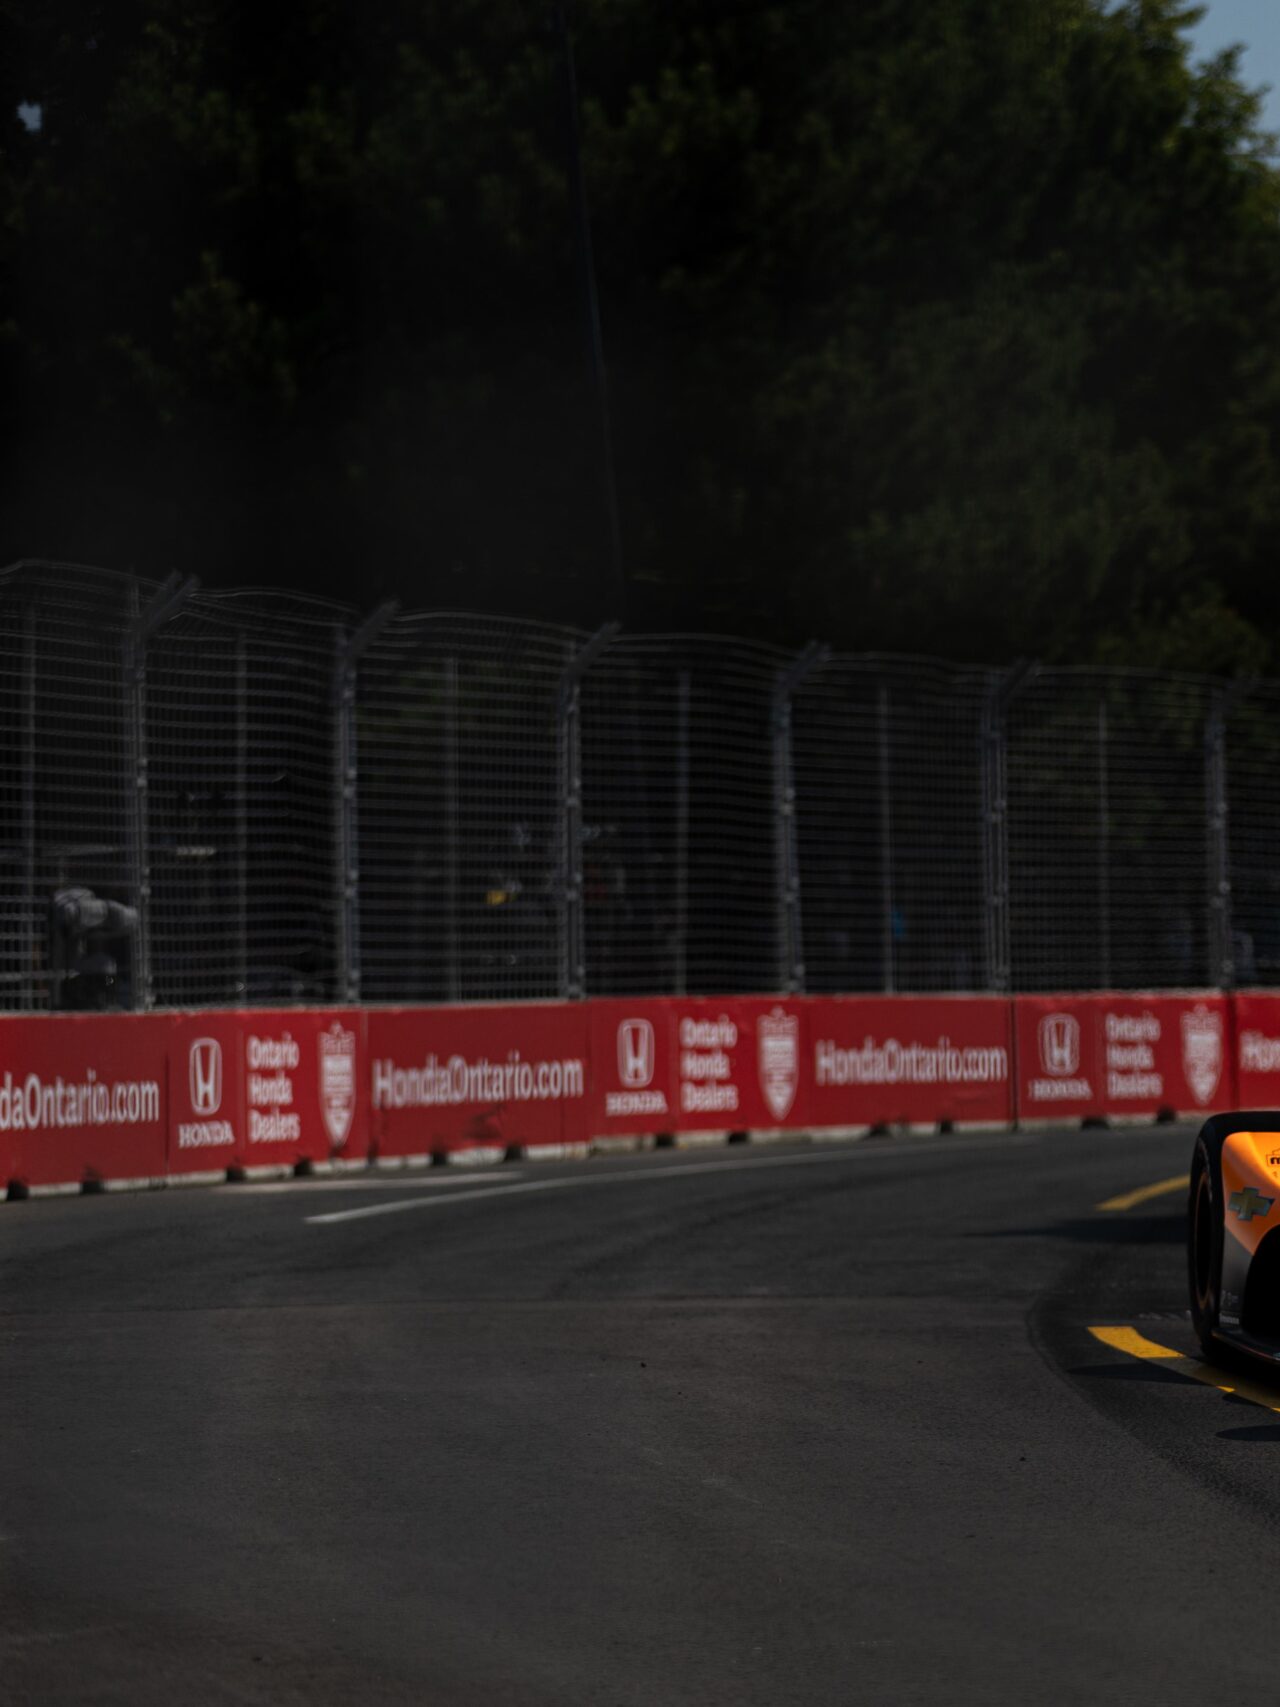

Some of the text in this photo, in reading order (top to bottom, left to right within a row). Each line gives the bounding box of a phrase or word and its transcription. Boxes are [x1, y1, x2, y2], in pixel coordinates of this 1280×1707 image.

[246, 1030, 300, 1070] Ontario
[815, 1037, 1008, 1086] HondaOntario.com
[247, 1068, 293, 1106] Honda
[372, 1050, 584, 1108] HondaOntario.com
[605, 1090, 668, 1117] HONDA
[178, 1120, 235, 1149] HONDA
[248, 1105, 301, 1144] Dealers
